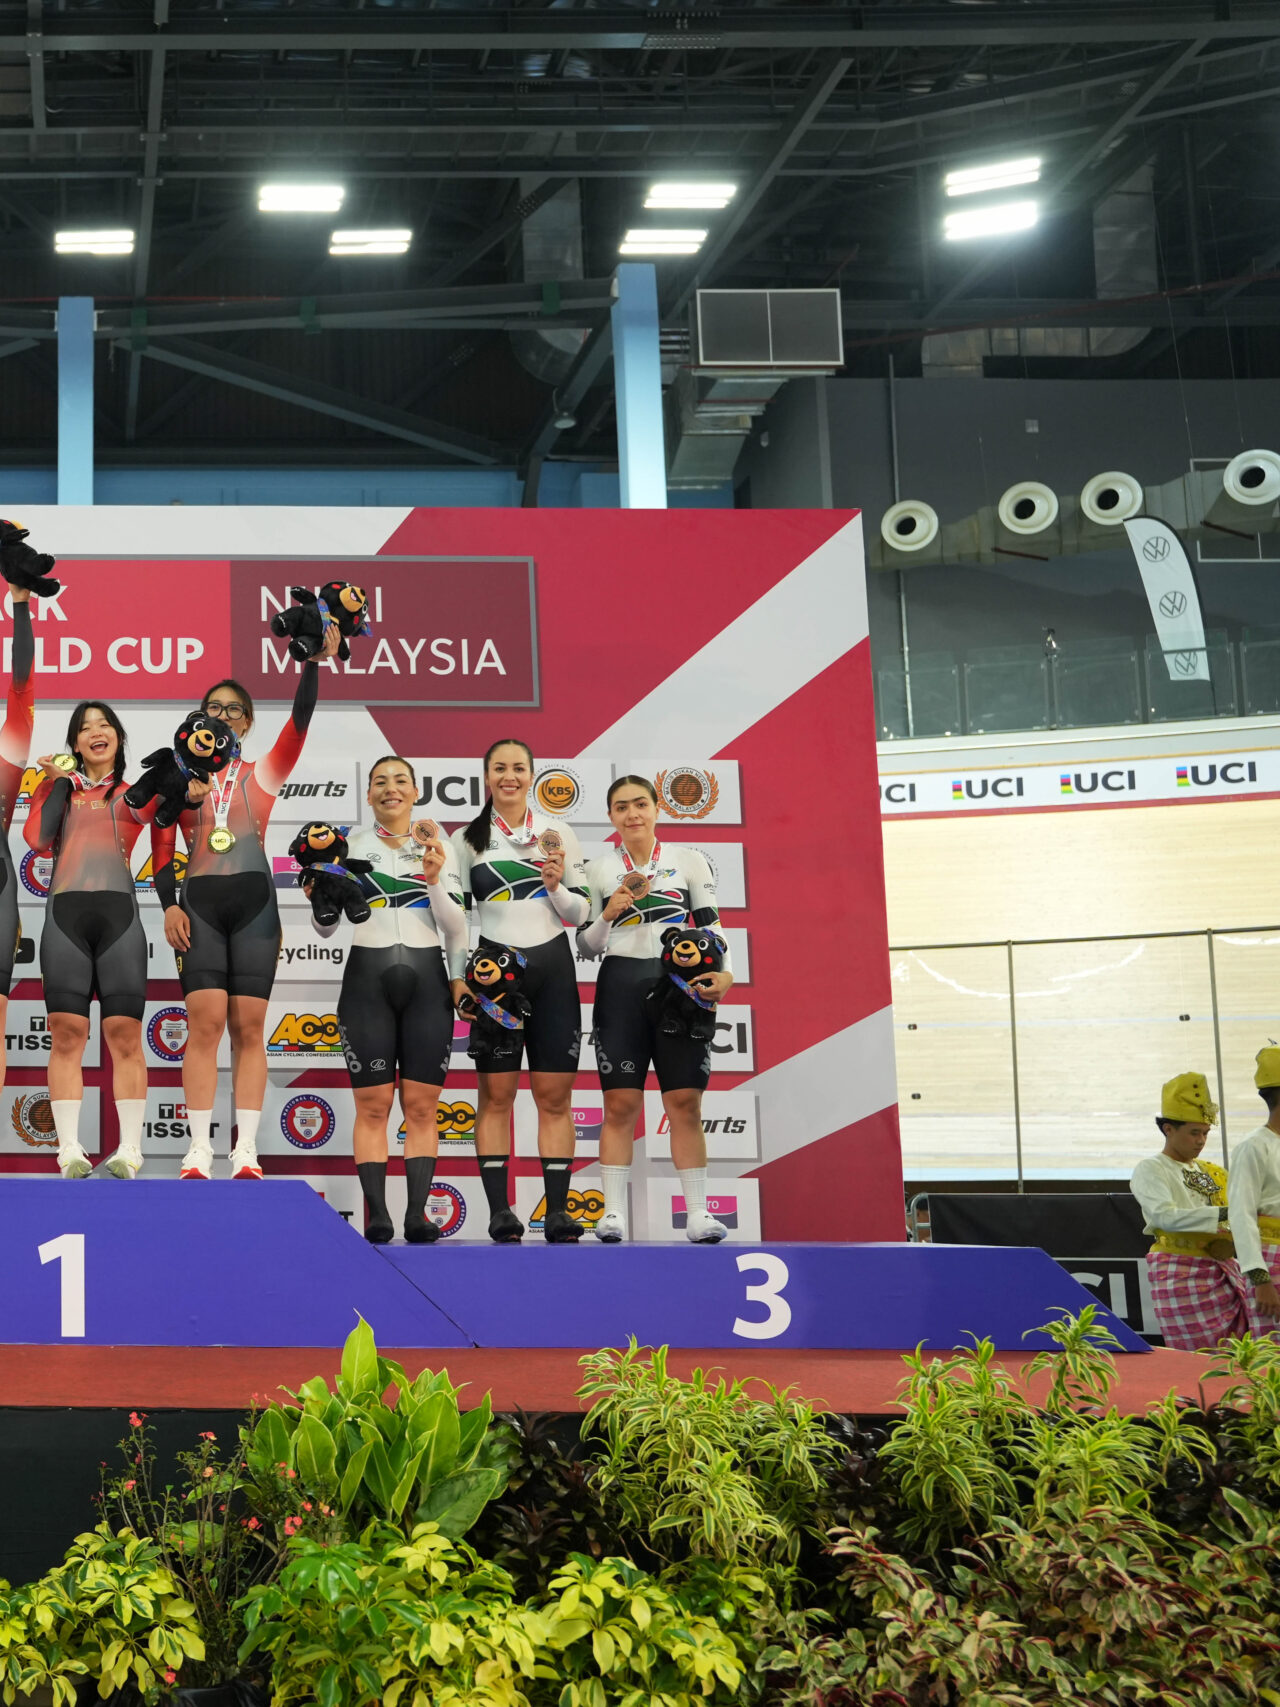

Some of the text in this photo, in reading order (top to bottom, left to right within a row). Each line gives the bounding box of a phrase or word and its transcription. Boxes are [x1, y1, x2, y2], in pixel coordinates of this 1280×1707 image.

[106, 637, 205, 674] CUP
[1074, 770, 1136, 793] UCI
[1191, 762, 1257, 786] UCI
[548, 787, 572, 797] KBS
[879, 783, 916, 803] CI
[965, 777, 1024, 799] UCI
[4, 1034, 52, 1050] TISS
[712, 1022, 748, 1054] CI
[37, 1234, 86, 1337] 1
[733, 1253, 792, 1340] 3
